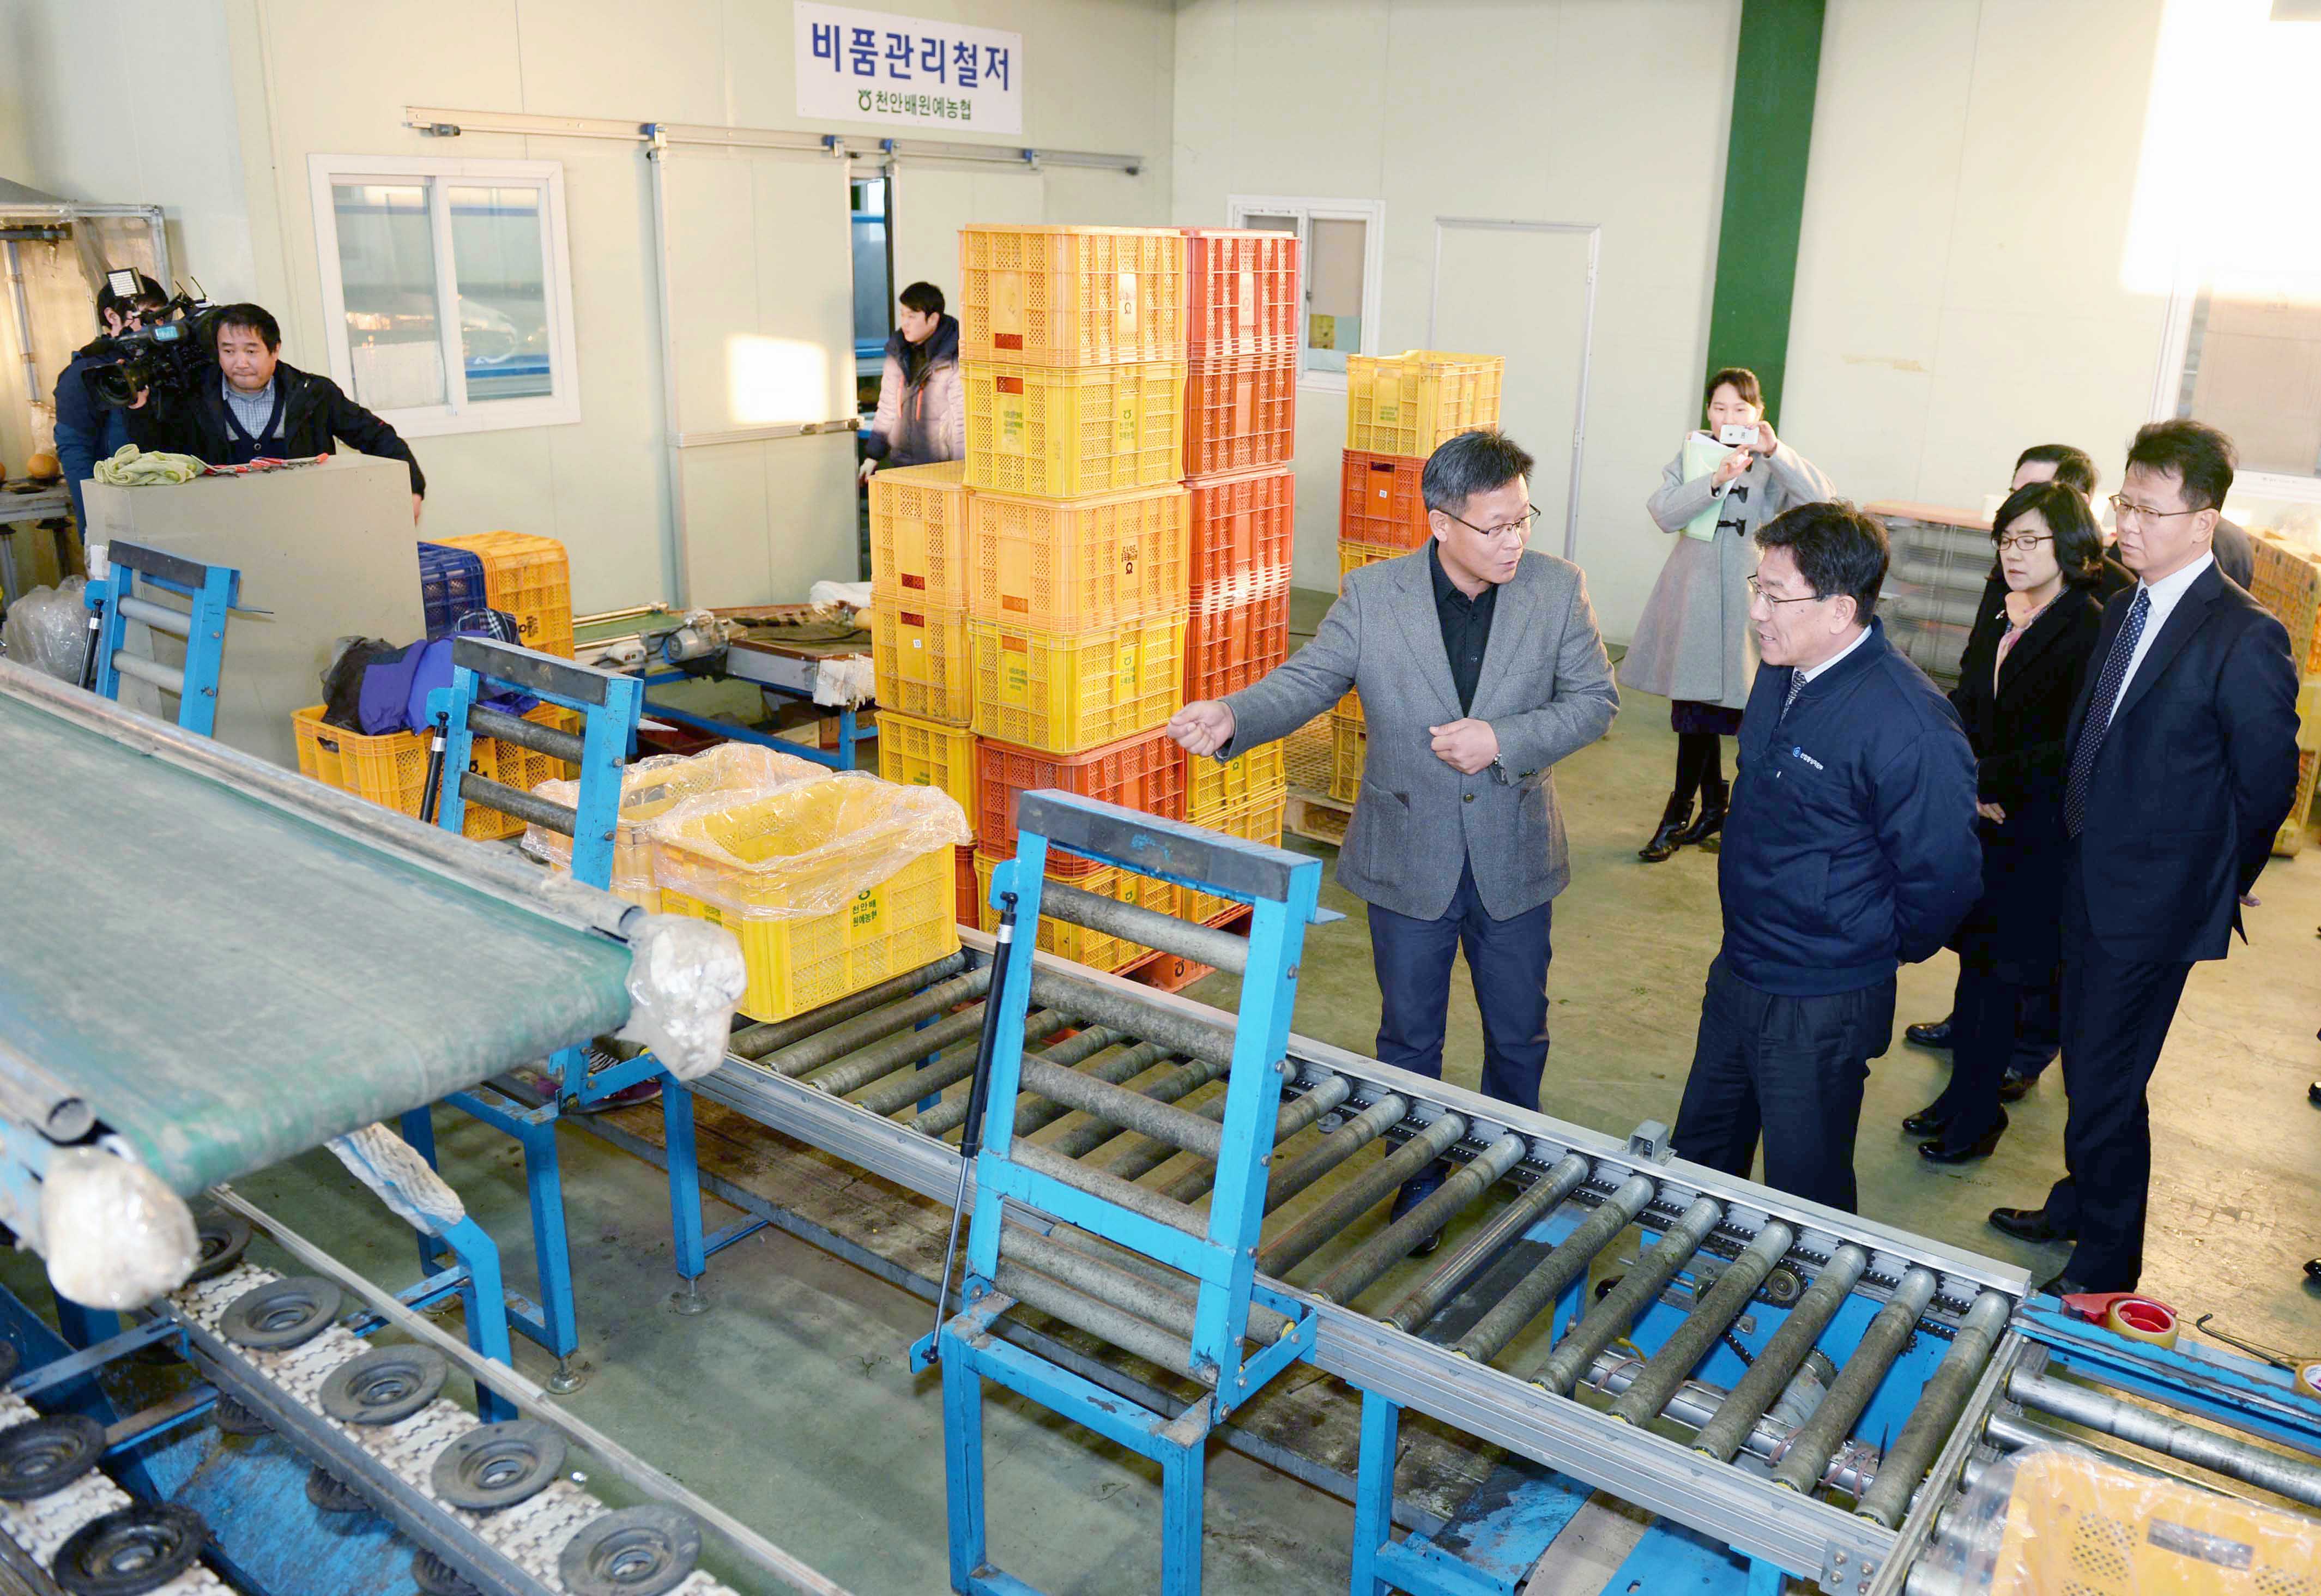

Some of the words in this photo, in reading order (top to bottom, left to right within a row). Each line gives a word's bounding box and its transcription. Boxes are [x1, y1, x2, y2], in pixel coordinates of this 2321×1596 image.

[812, 23, 1009, 91] 비품관리철저
[876, 90, 971, 120] 천안배원예농협
[853, 898, 877, 915] 천안배
